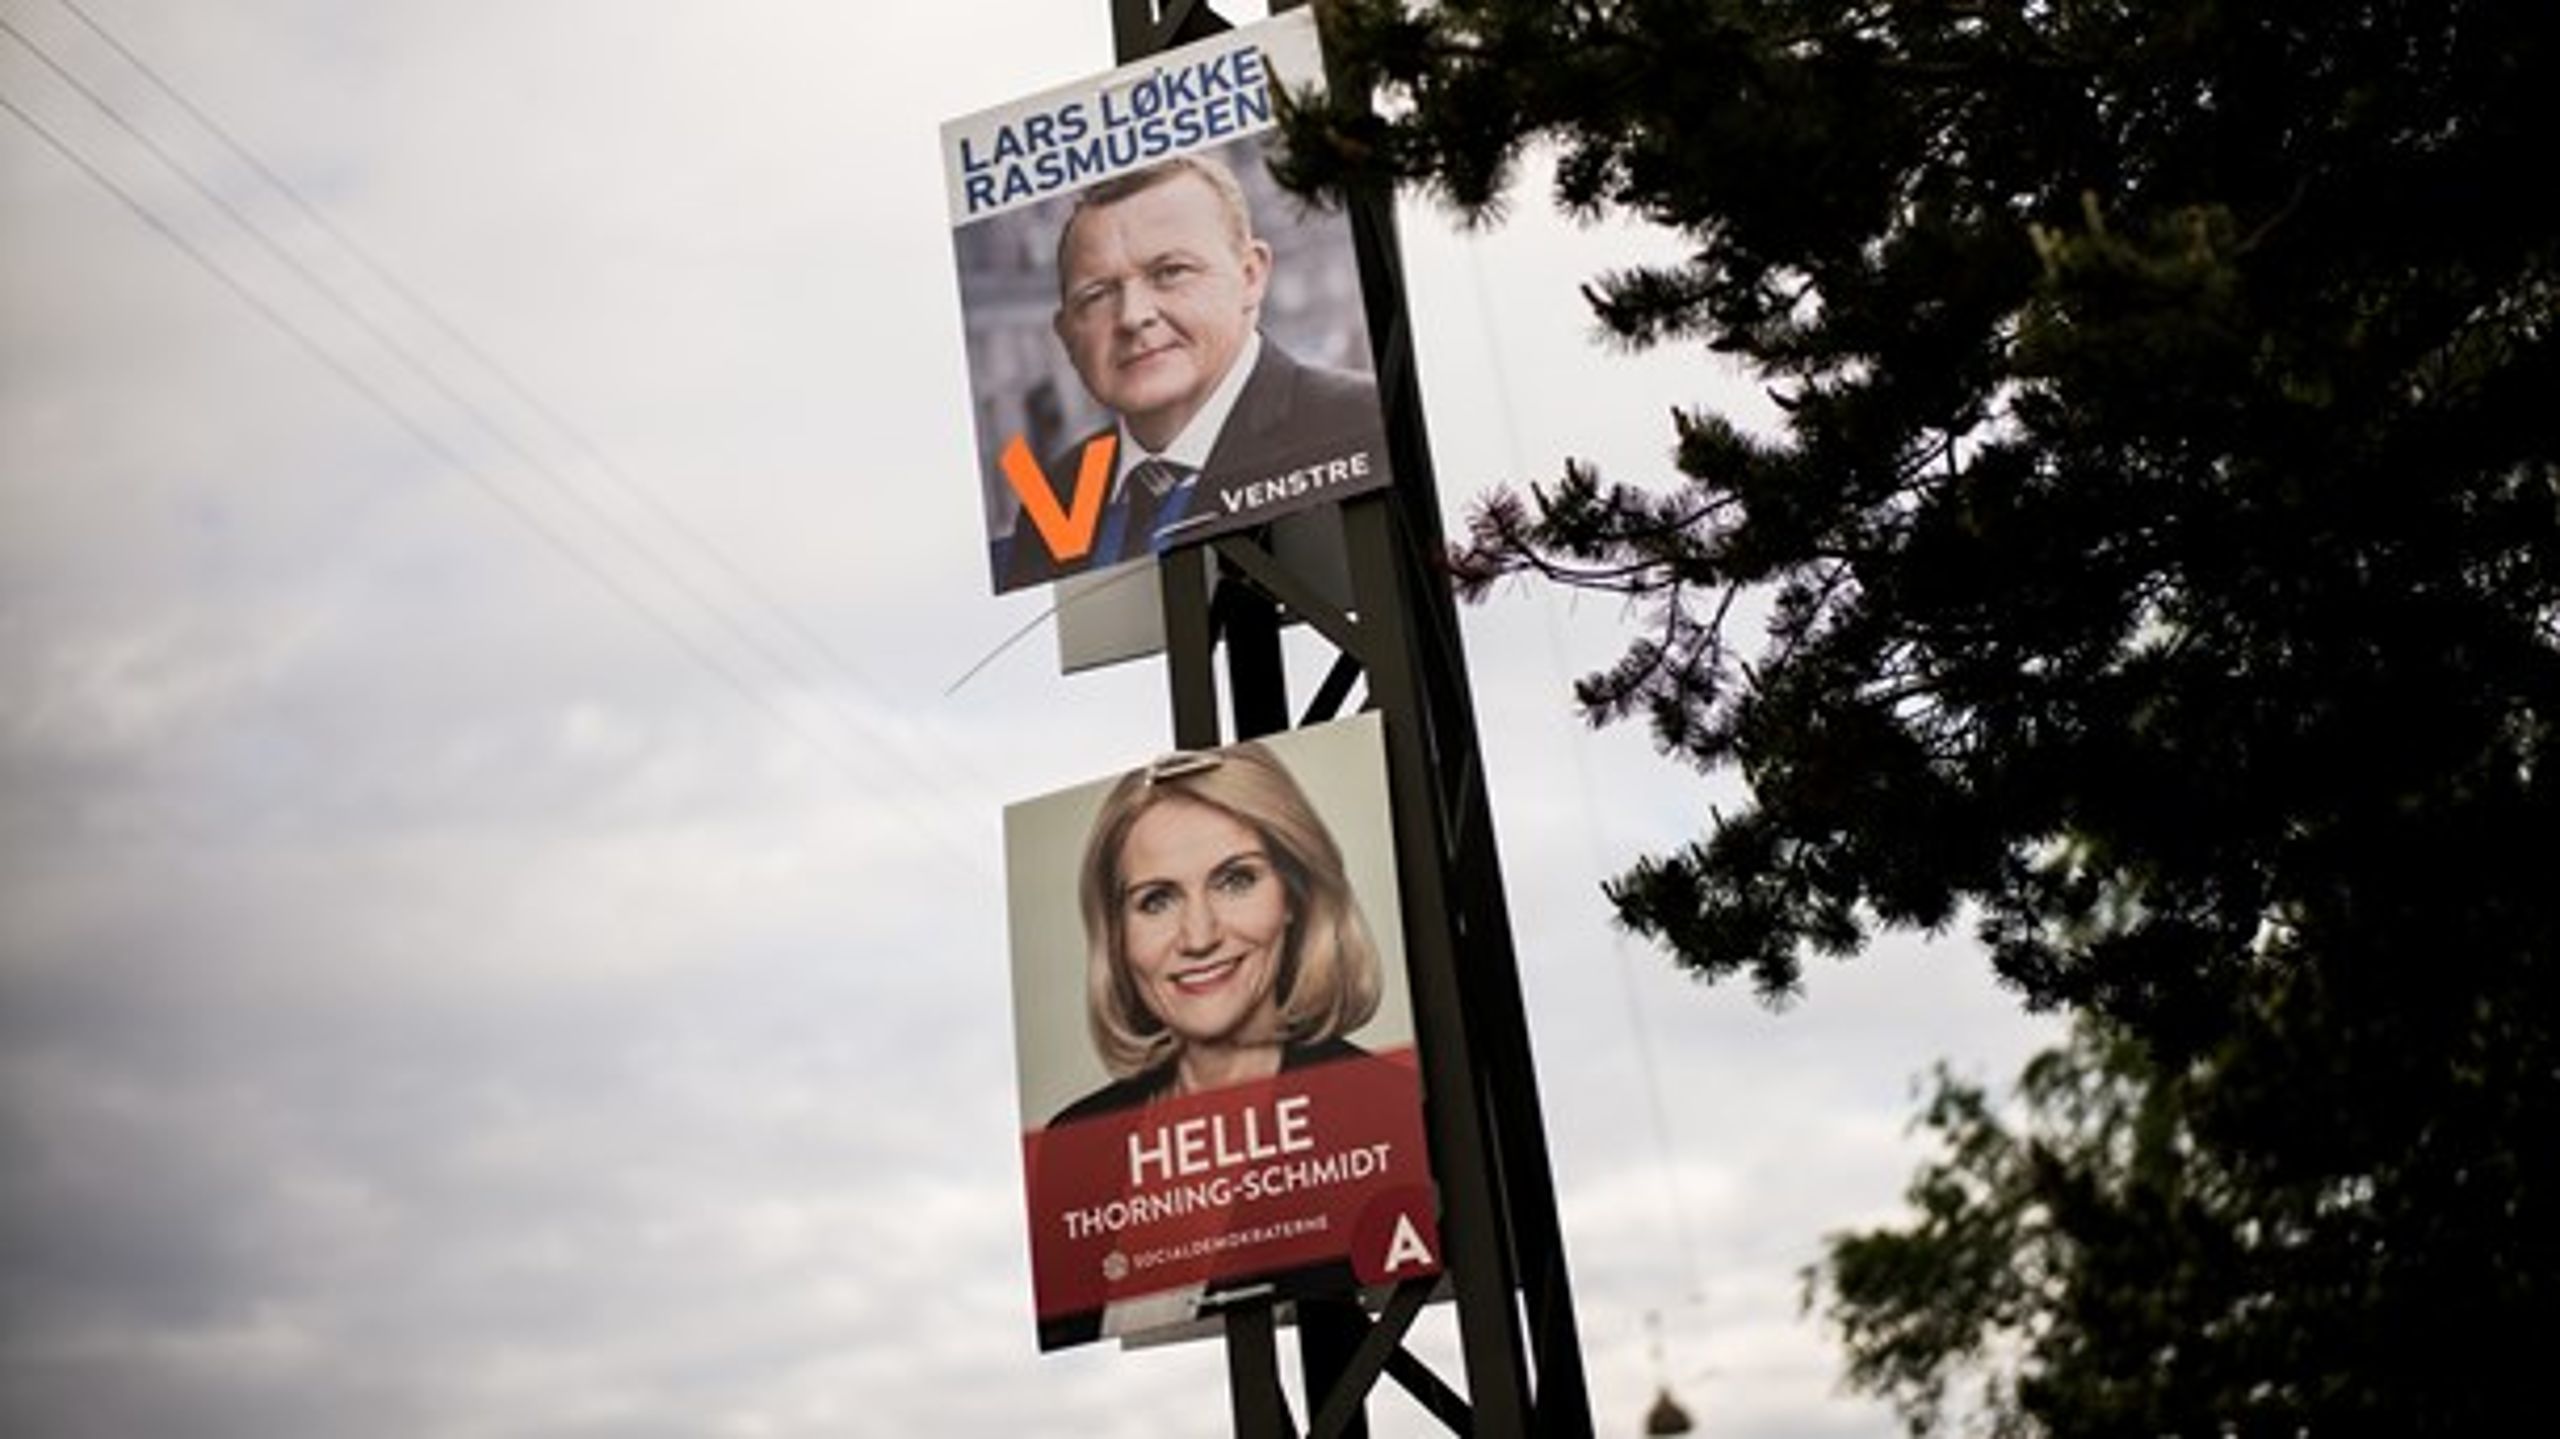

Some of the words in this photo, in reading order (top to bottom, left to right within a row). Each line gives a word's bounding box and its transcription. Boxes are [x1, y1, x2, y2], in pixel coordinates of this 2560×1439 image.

[960, 104, 1088, 173] LARS
[1101, 45, 1262, 127] LØKKE
[964, 87, 1271, 213] RASMUSSEN
[998, 431, 1117, 561] V
[1220, 453, 1370, 514] VENSTRE
[1127, 1096, 1314, 1186] HELLE
[1063, 1144, 1391, 1240] THORNING-SCHMIDT
[1133, 1215, 1328, 1268] SOCIALDEMOKRATERNE
[1384, 1213, 1433, 1272] A
